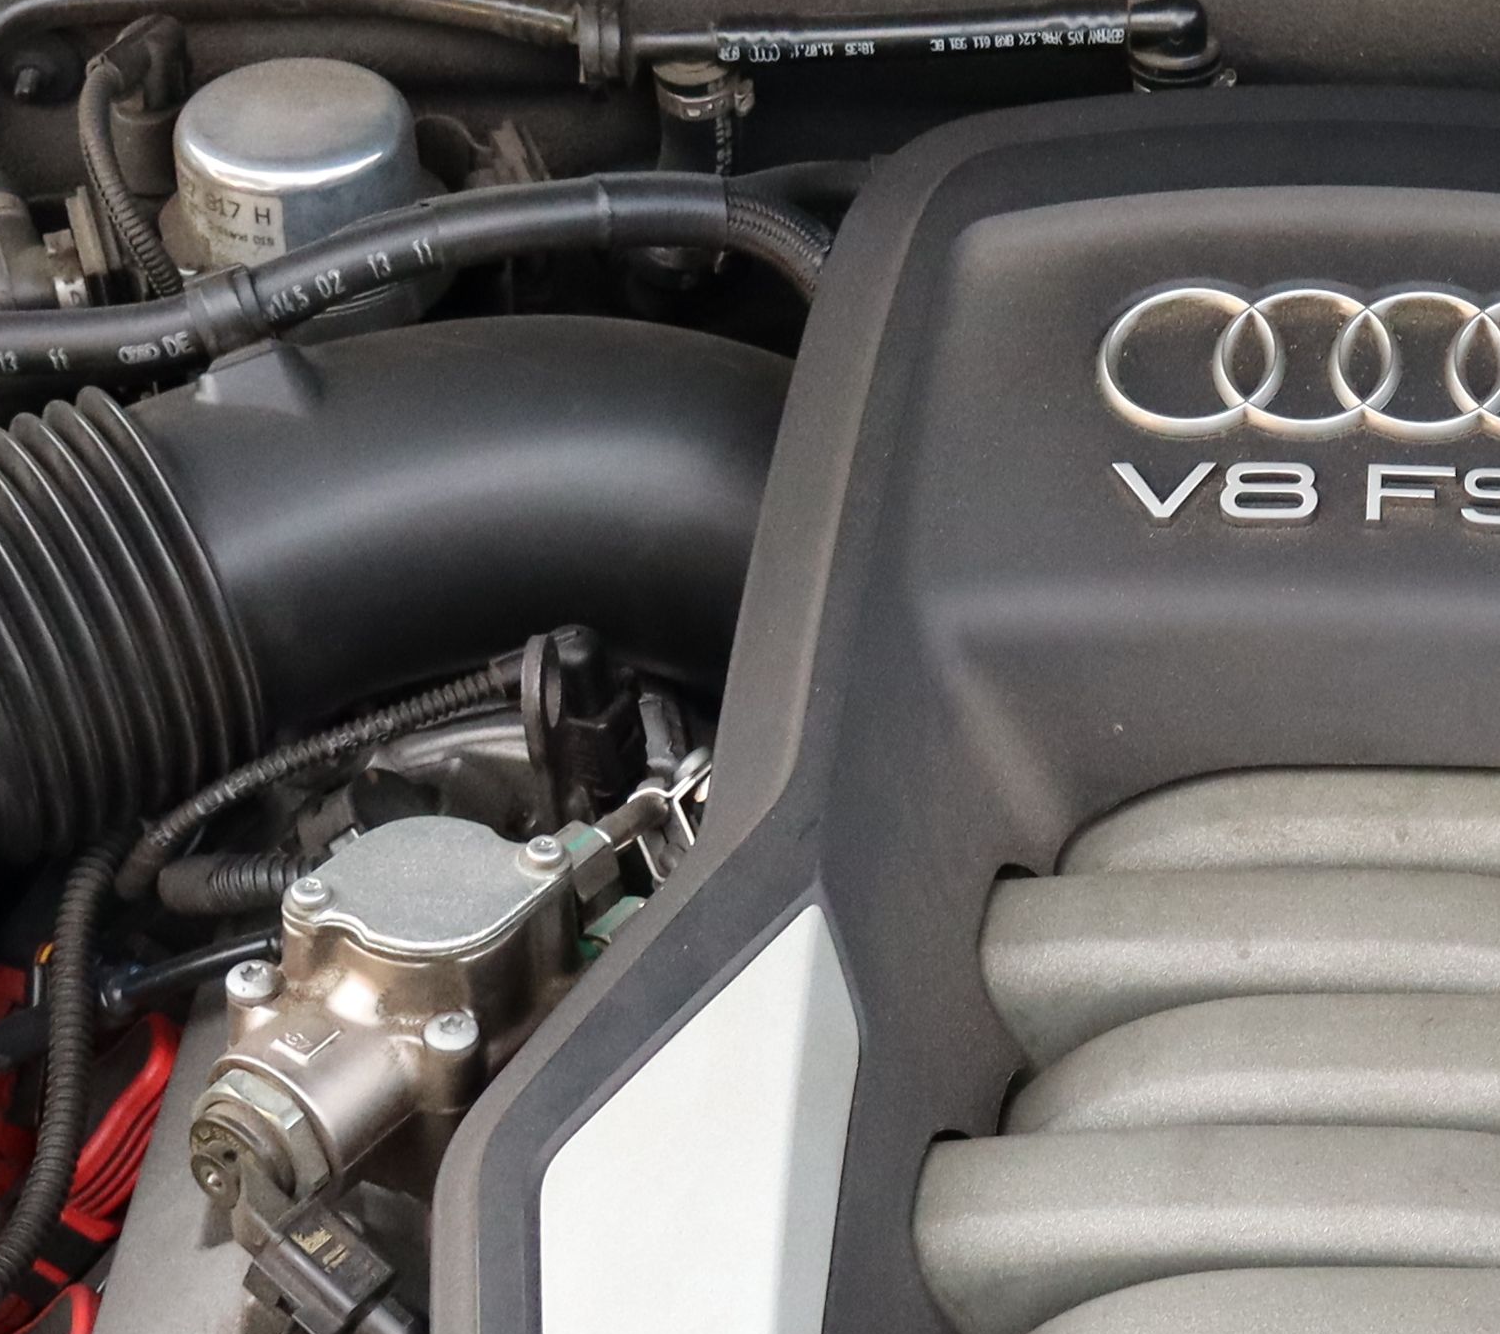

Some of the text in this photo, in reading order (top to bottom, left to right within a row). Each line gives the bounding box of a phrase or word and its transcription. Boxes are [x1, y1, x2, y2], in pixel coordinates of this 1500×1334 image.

[253, 205, 272, 226] H
[314, 269, 347, 300] 02
[161, 331, 195, 357] DE
[1112, 461, 1319, 520] V8
